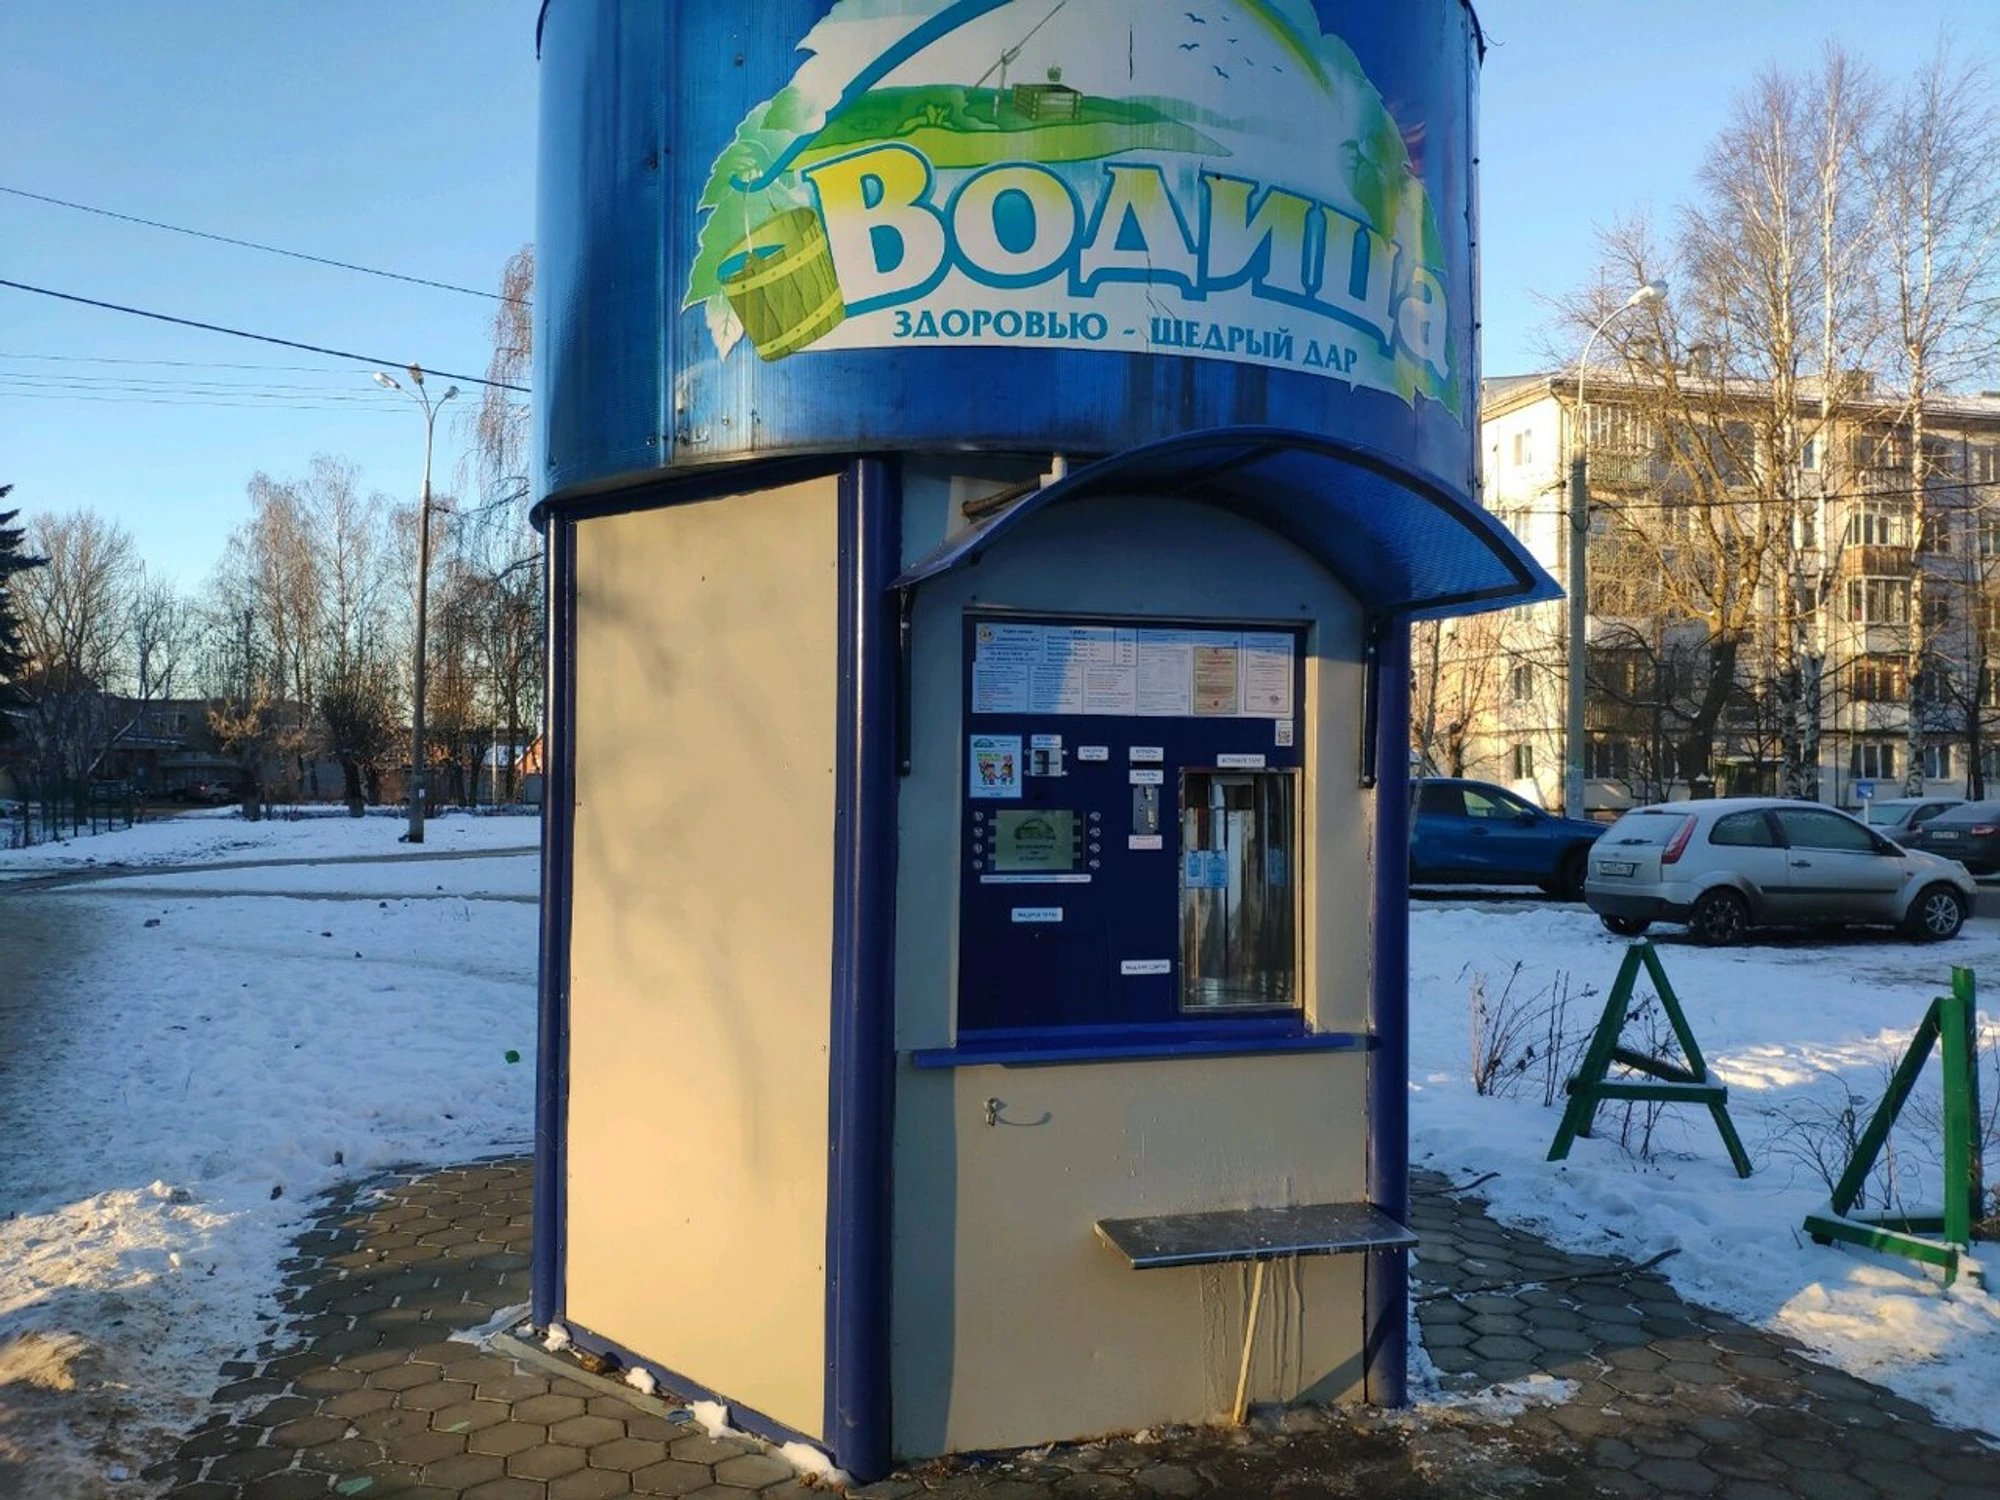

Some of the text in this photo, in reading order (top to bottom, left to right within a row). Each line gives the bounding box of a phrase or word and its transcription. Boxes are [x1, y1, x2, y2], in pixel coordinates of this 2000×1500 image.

[893, 309, 1108, 340] ЗДОРОВЬЮ
[1151, 317, 1294, 361] ЩЕДРЫЙ
[1302, 339, 1358, 373] ДАР
